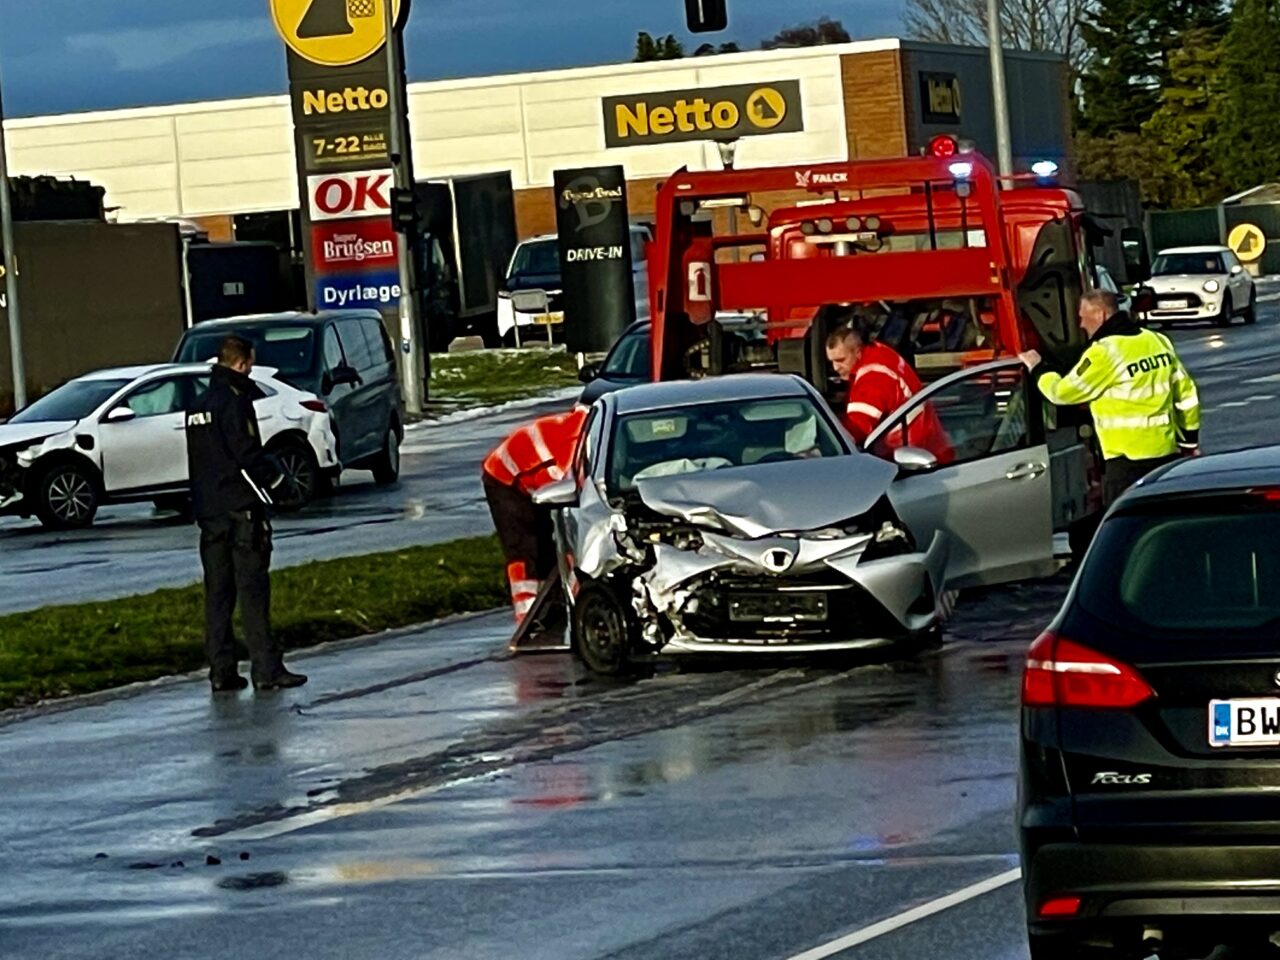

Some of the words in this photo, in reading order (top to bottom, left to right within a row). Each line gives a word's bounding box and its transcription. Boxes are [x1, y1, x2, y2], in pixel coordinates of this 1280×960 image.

[303, 86, 388, 115] Netto
[615, 97, 739, 138] Netto
[313, 135, 361, 156] 7-22
[811, 172, 848, 184] FALCK
[314, 174, 392, 215] OK
[323, 238, 394, 262] Brugsen
[566, 245, 623, 262] DRIVE-IN
[323, 284, 401, 306] Dyrlæge
[1236, 706, 1280, 736] BW
[1091, 771, 1152, 785] Focus
